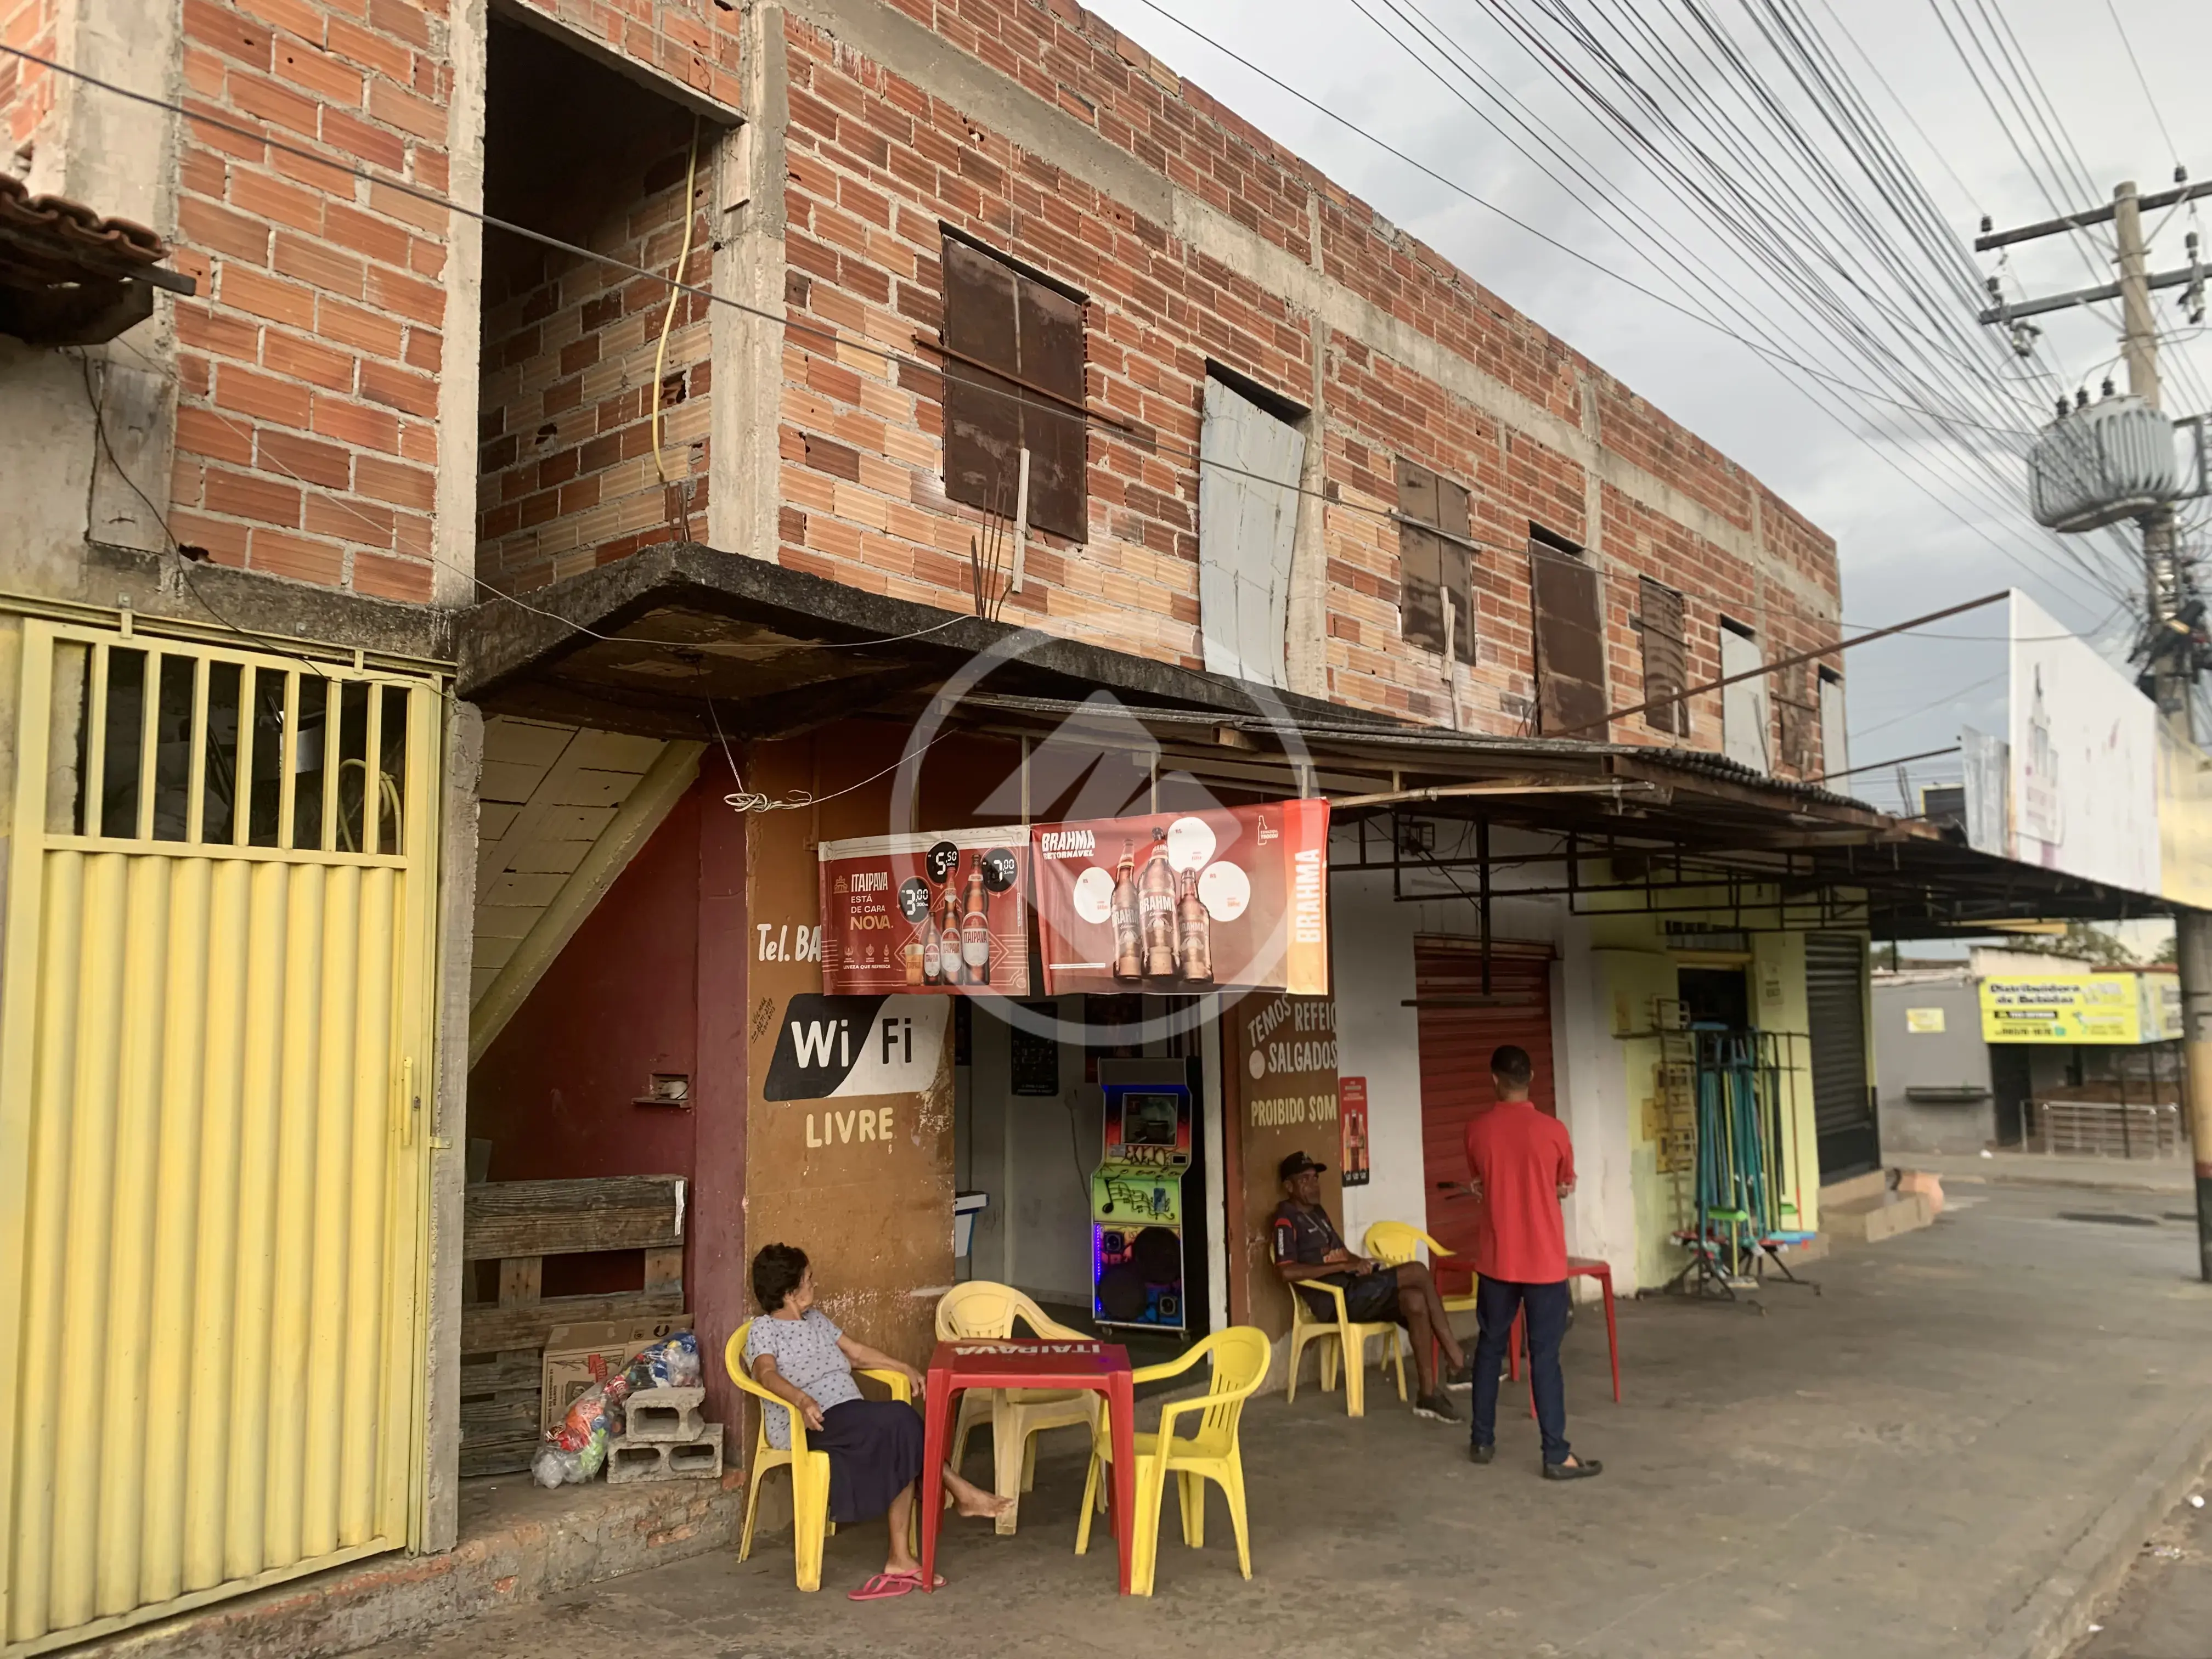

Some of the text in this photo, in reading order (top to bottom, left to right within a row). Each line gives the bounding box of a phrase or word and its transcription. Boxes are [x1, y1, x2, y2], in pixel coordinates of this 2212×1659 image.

[1042, 830, 1095, 852] BRAHMA
[935, 851, 957, 875] 5,50
[1043, 849, 1094, 860] RETORNÁVEL
[851, 872, 888, 893] ITAIPAVA
[851, 894, 872, 904] ESTÁ
[906, 889, 928, 915] 3,00
[1295, 849, 1321, 943] BRAHMA
[850, 915, 894, 930] NOVA.
[757, 923, 790, 962] Tel.
[943, 943, 960, 953] ITAIPAVA
[964, 931, 988, 944] ITAIPAVA
[1247, 993, 1291, 1048] TEMOS
[791, 1018, 912, 1068] Wi Fi
[1268, 1040, 1338, 1074] SALGADOS
[1251, 1094, 1337, 1126] PROIBIDO SOM
[806, 1107, 894, 1148] LIVRE
[955, 1344, 1100, 1356] ITAIPAVA
